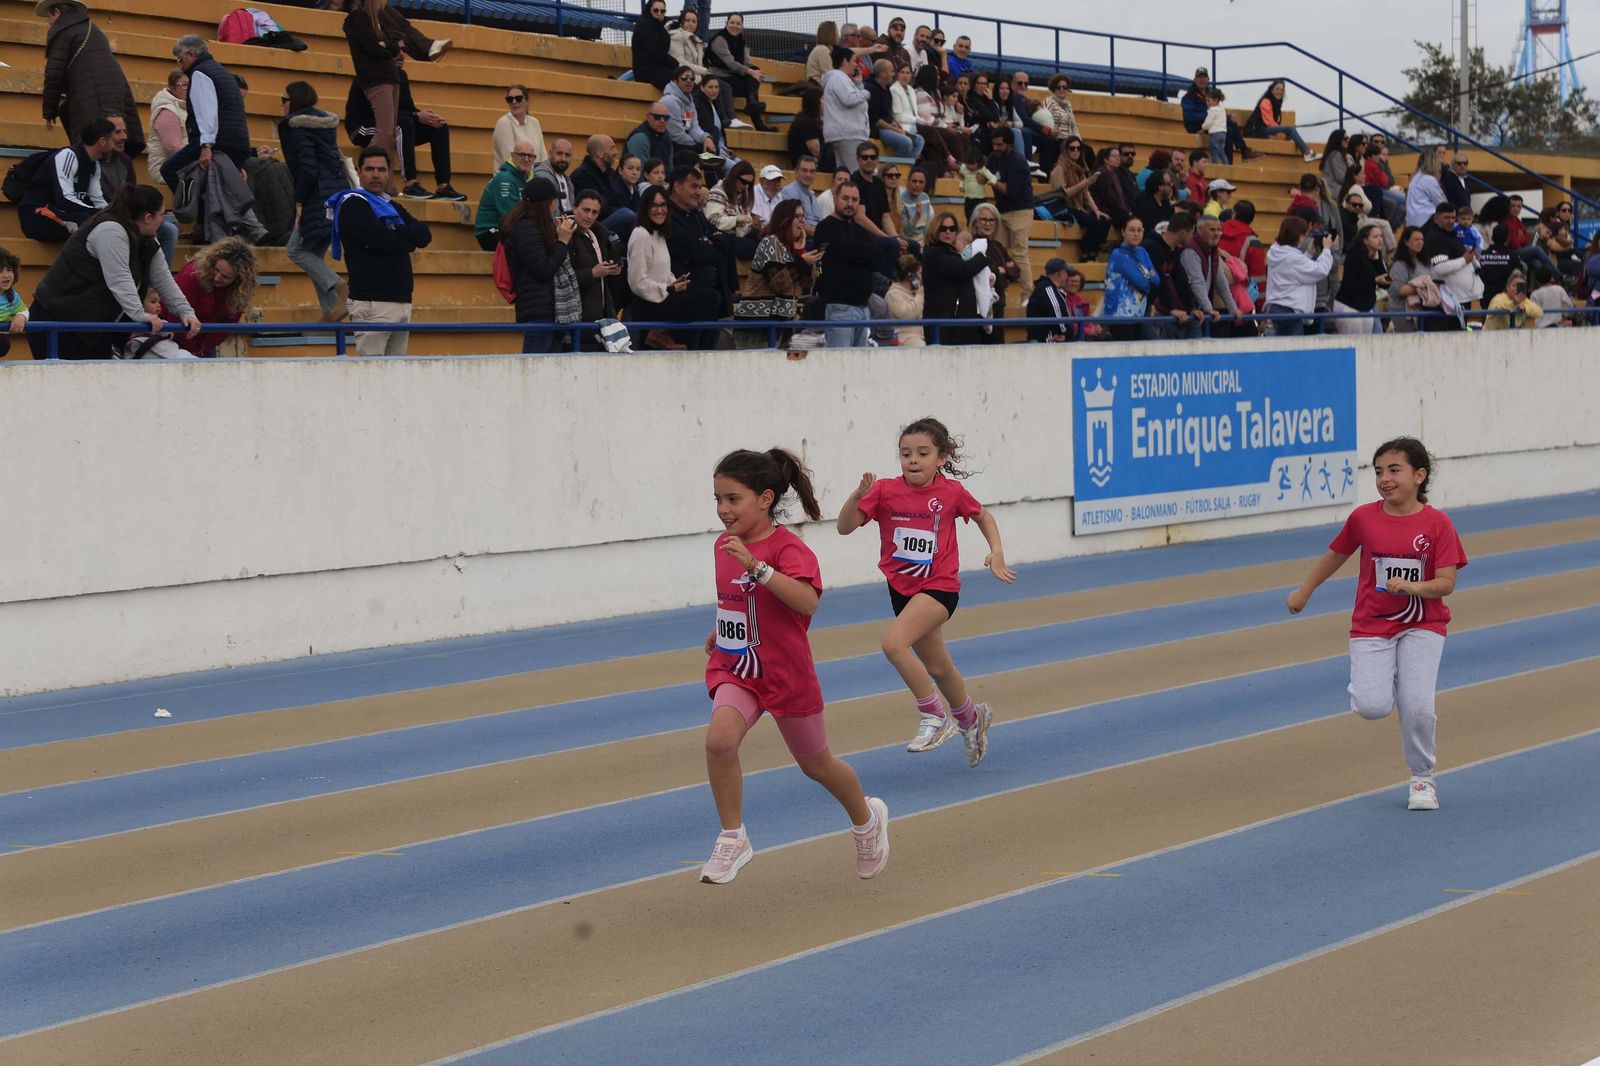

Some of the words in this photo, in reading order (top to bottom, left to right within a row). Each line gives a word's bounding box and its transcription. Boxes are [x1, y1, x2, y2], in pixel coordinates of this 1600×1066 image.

[1130, 372, 1179, 398] ESTADIO
[1182, 370, 1242, 396] MUNICIPAL
[1132, 402, 1232, 467] Enrique
[1236, 397, 1335, 450] Talavera
[1082, 508, 1123, 526] ATLETISMO
[1131, 502, 1178, 521] BALONMANO
[1185, 497, 1212, 514] FÚTBOL
[1213, 496, 1231, 511] SALA
[1239, 493, 1261, 508] RUGBY
[903, 536, 934, 554] 1091
[1385, 566, 1420, 582] 1078
[718, 618, 746, 641] 1086
